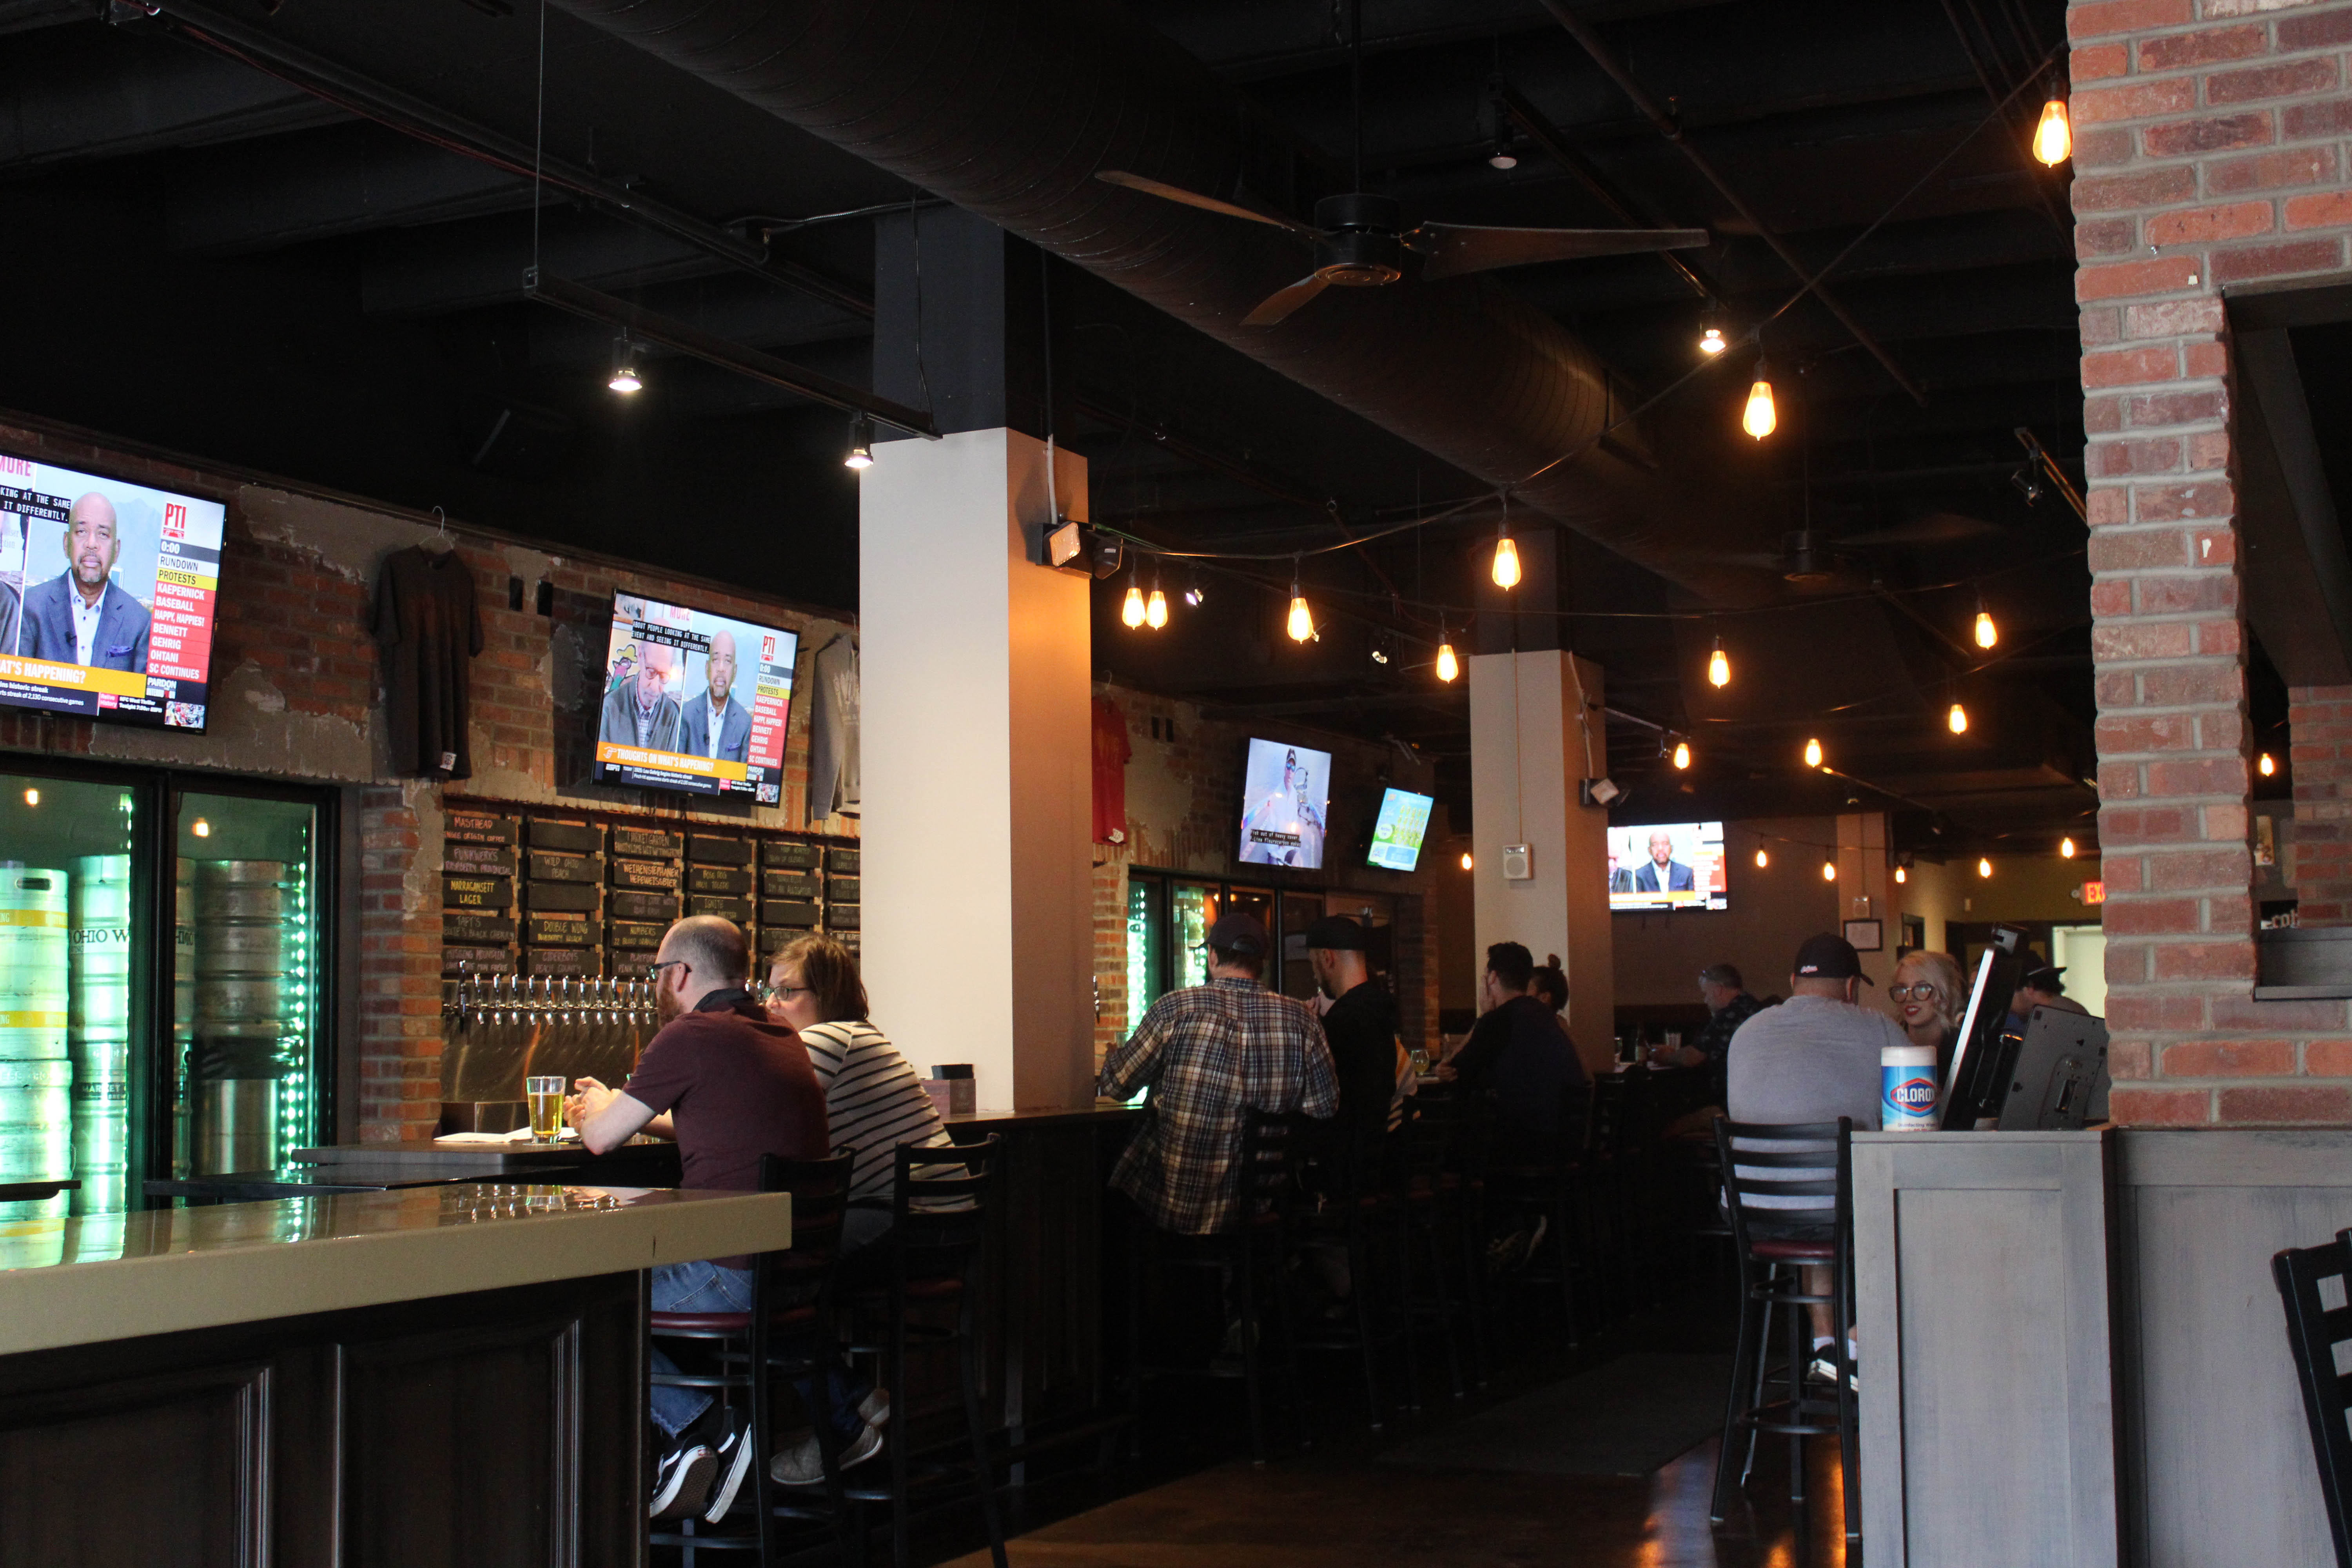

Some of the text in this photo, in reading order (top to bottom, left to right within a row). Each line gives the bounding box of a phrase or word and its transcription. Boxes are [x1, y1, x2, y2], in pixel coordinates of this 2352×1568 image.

[22, 492, 32, 501] AT
[36, 494, 49, 505] THE
[53, 498, 71, 509] SAME
[4, 501, 68, 522] IT DIFFERENTLY.
[165, 503, 187, 530] PTI
[161, 541, 180, 555] 0:00
[160, 556, 199, 571] RUNDOWN
[158, 570, 196, 584] PROTESTS
[157, 583, 205, 601] KAEPERNICK
[156, 596, 194, 612] BASEBALL
[154, 609, 205, 627] HAPPY, HAPPIES!
[153, 622, 188, 637] BENNETT
[647, 624, 662, 633] PEOPLE
[664, 627, 682, 637] LOOKING
[152, 636, 181, 650] GEHRIG
[656, 635, 672, 645] SEEING
[680, 641, 709, 653] DIFFERENTLY.
[762, 635, 775, 655] PTI
[150, 650, 179, 663] OHTANI
[24, 662, 87, 684] HAPPENING?
[149, 663, 200, 679] SC CONTINUES
[9, 682, 31, 691] historic
[31, 685, 49, 693] streak
[147, 677, 177, 689] PARDON
[759, 675, 780, 686] RUNDOWN
[757, 685, 779, 696] PROTESTS
[756, 694, 784, 707] KAEPERNICK
[755, 705, 777, 716] BASEBALL
[752, 725, 773, 735] BENNETT
[751, 735, 768, 745] GEHRIG
[617, 748, 714, 772] THOUGHTS ON WHAT'S HAPPENING?
[454, 816, 493, 829] MASTHEAD
[450, 880, 495, 893] NARRAGANSETT
[459, 894, 482, 905] LAGER
[83, 1083, 120, 1093] MARET
